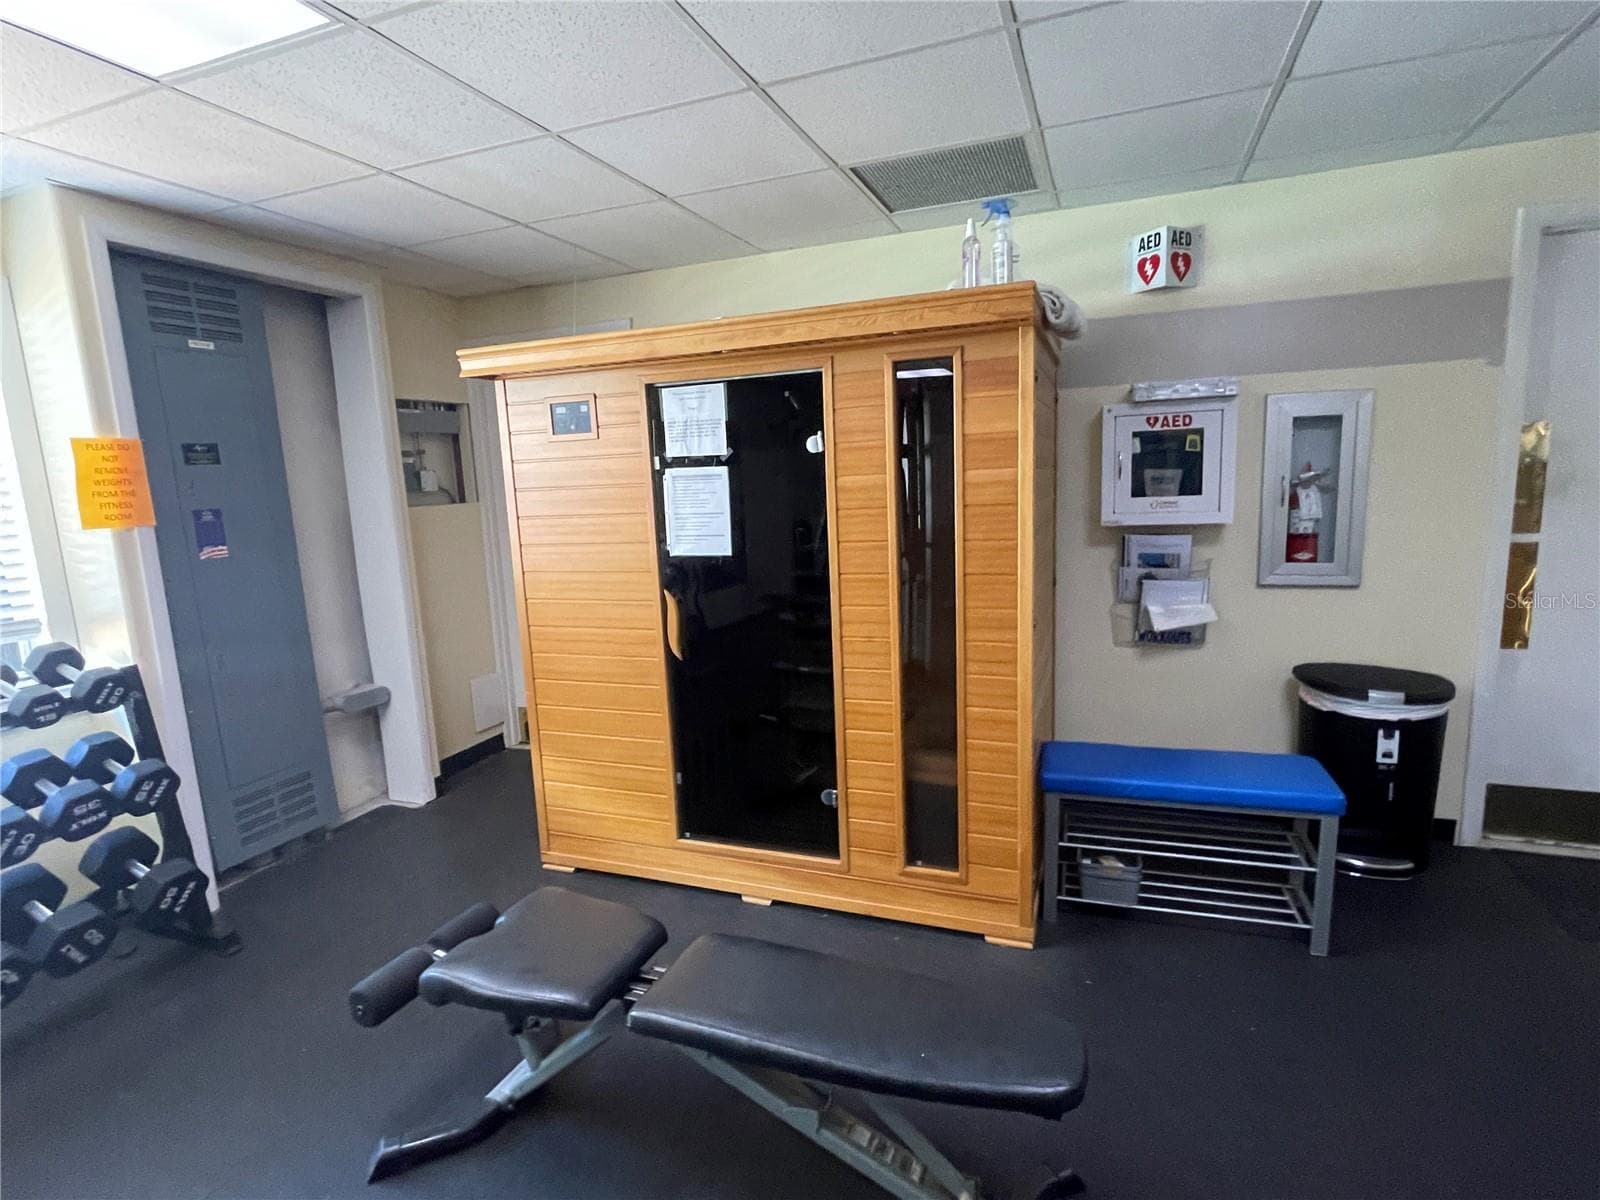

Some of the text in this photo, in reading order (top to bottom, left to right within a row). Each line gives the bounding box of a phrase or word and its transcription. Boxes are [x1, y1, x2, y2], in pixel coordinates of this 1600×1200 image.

[1138, 232, 1162, 253] AED
[1171, 230, 1193, 247] AED
[1160, 414, 1193, 428] AED
[85, 443, 131, 452] PLEASE DO
[102, 455, 119, 464] NOT
[94, 467, 128, 475] REMOVE
[93, 478, 133, 487] WEIGHTS
[91, 489, 137, 499] FROM THE
[99, 502, 134, 510] FITNESS
[104, 513, 134, 522] ROOM
